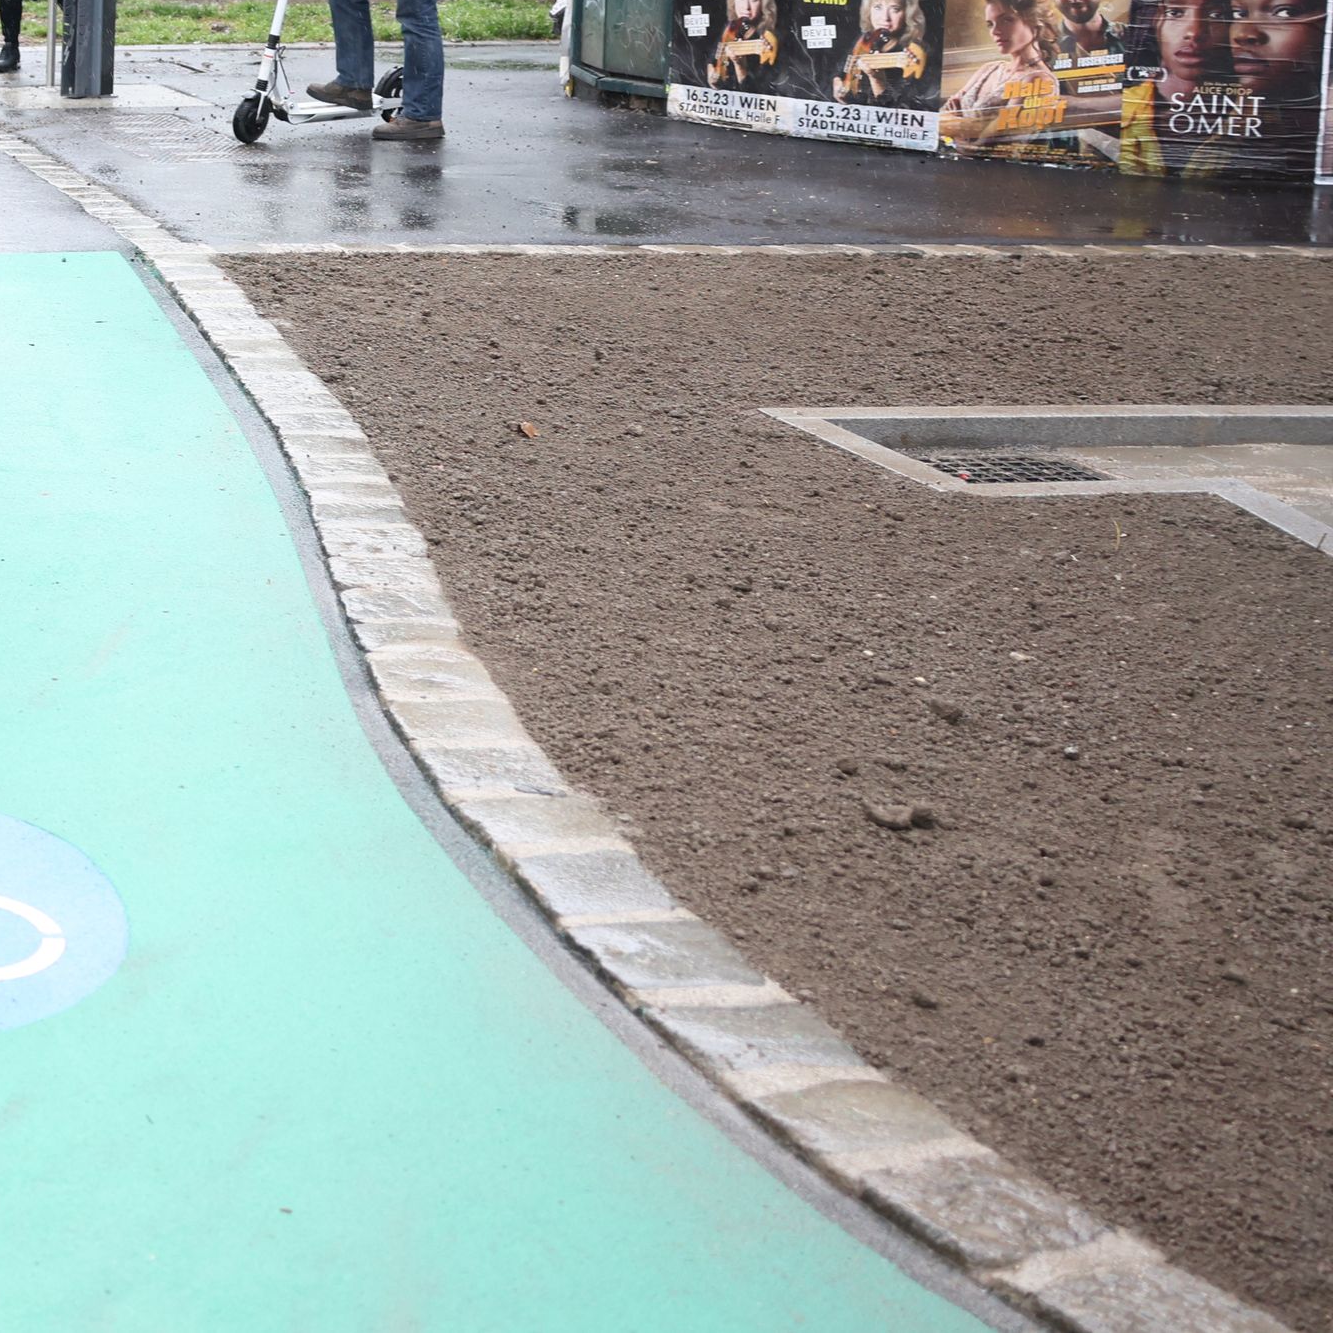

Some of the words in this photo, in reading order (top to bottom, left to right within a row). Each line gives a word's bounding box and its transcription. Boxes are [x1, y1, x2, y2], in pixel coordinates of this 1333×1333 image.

[803, 28, 835, 37] DEVIL
[685, 88, 729, 105] 16.5.23
[739, 95, 778, 112] WIEN
[1002, 77, 1056, 99] Hals
[1193, 86, 1222, 95] ALICE
[1226, 87, 1253, 96] DIOP
[679, 102, 743, 120] STADTHALLE,
[746, 112, 772, 124] Halle
[774, 115, 781, 125] F
[804, 103, 861, 121] 16.5.23
[875, 110, 925, 127] WIEN
[997, 99, 1069, 132] Kopf
[1169, 92, 1266, 116] SAINT
[798, 117, 880, 137] STADTHALLE,
[884, 126, 918, 140] Halle
[921, 130, 929, 141] F
[1168, 113, 1263, 137] OMER
